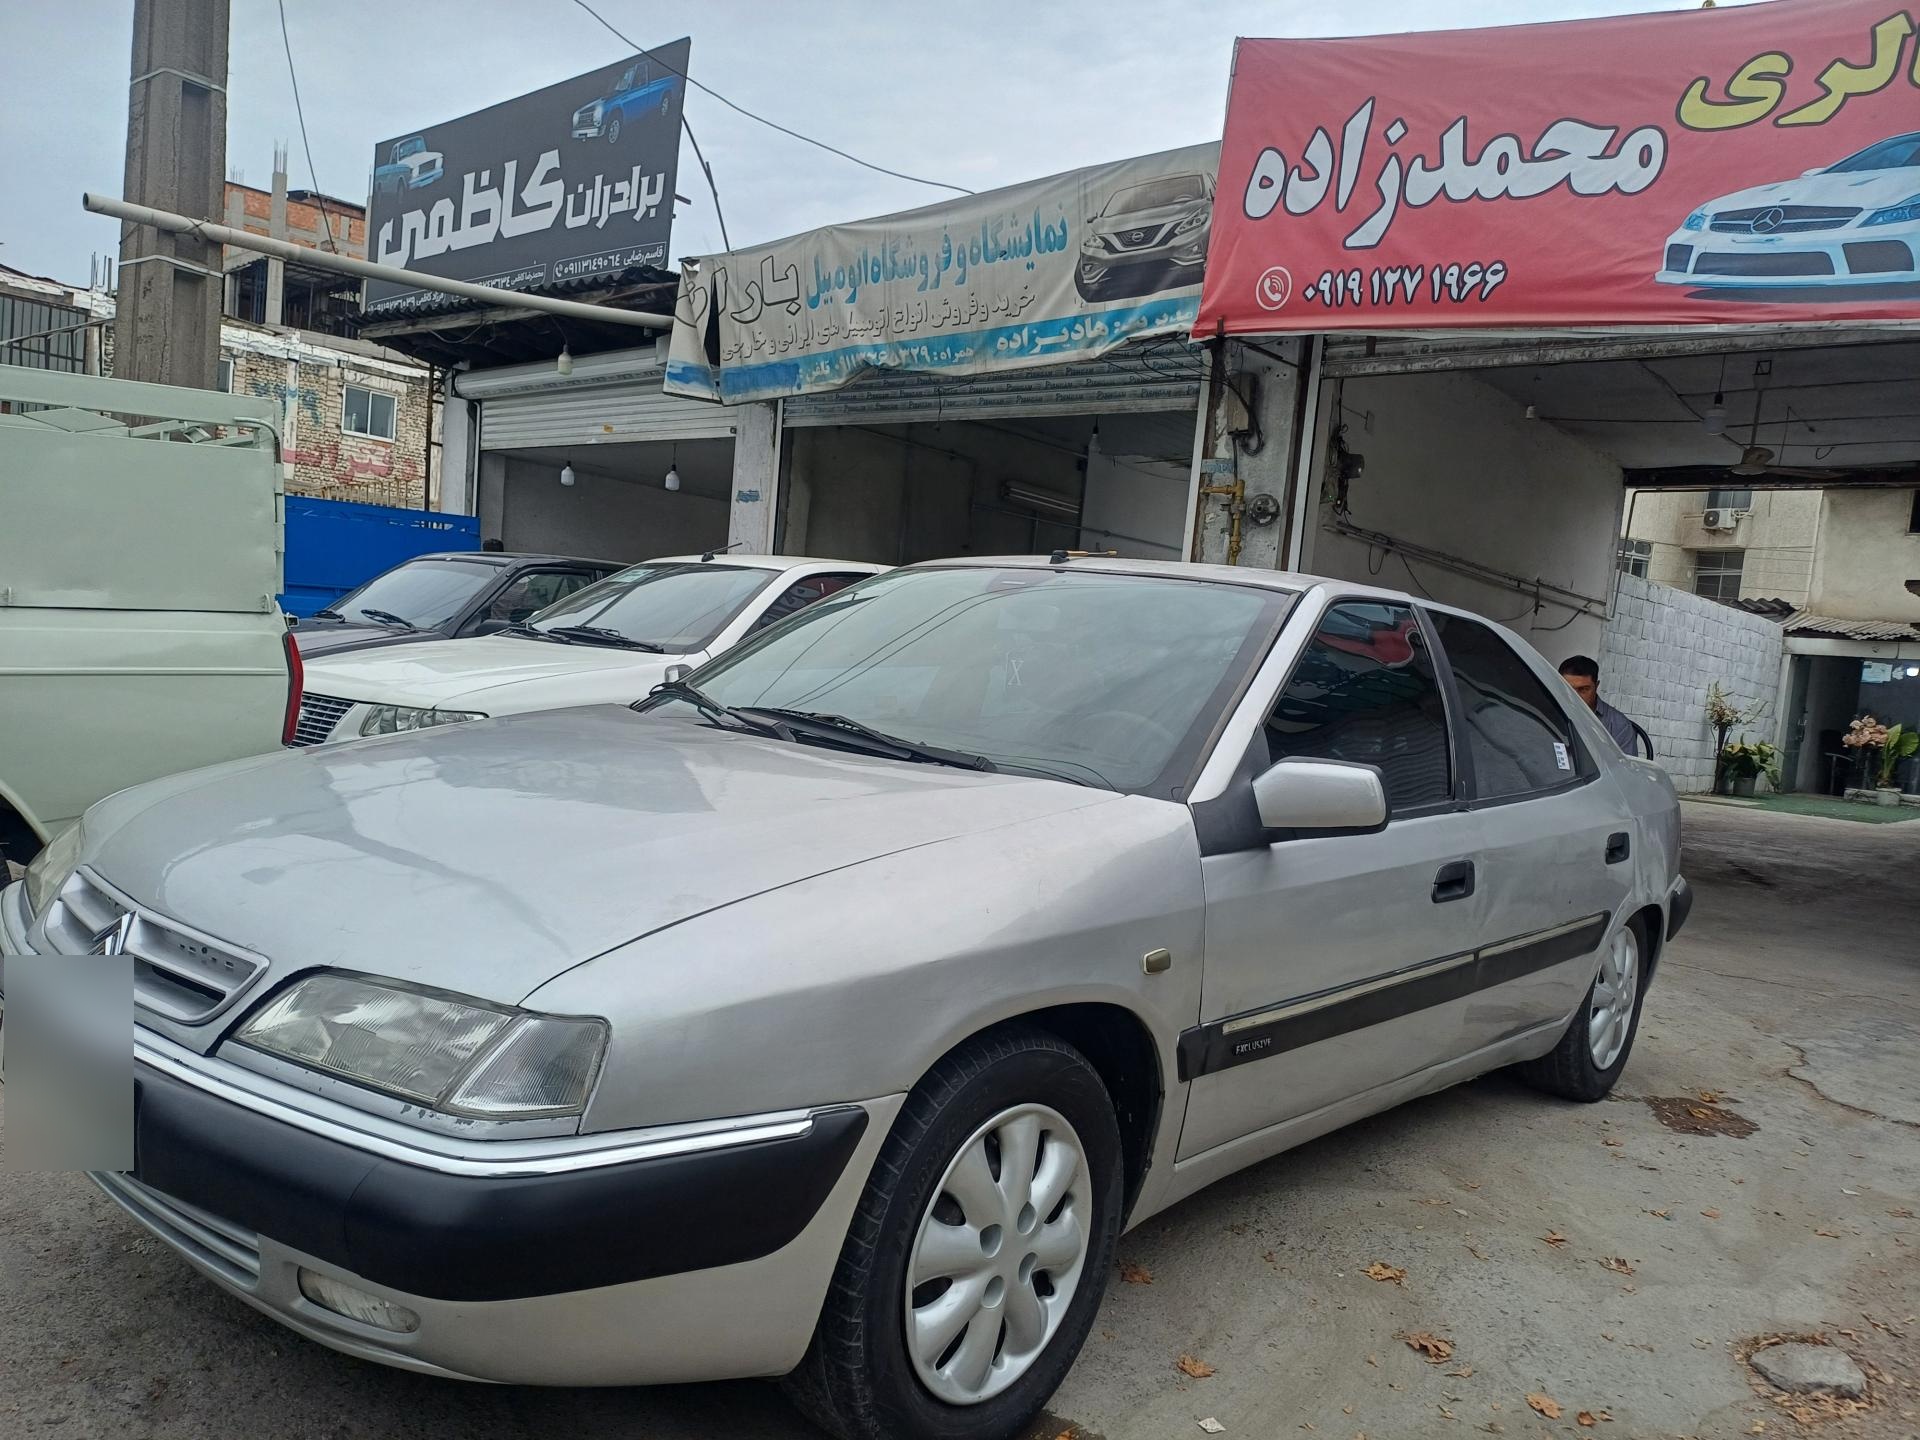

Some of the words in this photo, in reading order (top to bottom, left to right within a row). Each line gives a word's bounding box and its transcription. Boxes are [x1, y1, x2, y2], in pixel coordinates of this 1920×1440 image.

[565, 165, 665, 229] برادران
[1244, 96, 1668, 249] محمدزاده
[377, 149, 565, 269] کاظمی
[969, 202, 1068, 271] نمایشگاه
[806, 247, 869, 309] اتومبیل
[870, 225, 952, 291] فروشگاه
[1303, 269, 1363, 307] ۰۹۱۹
[1370, 265, 1425, 305] ۱۲۷
[1430, 259, 1508, 304] ۱۹۶۶
